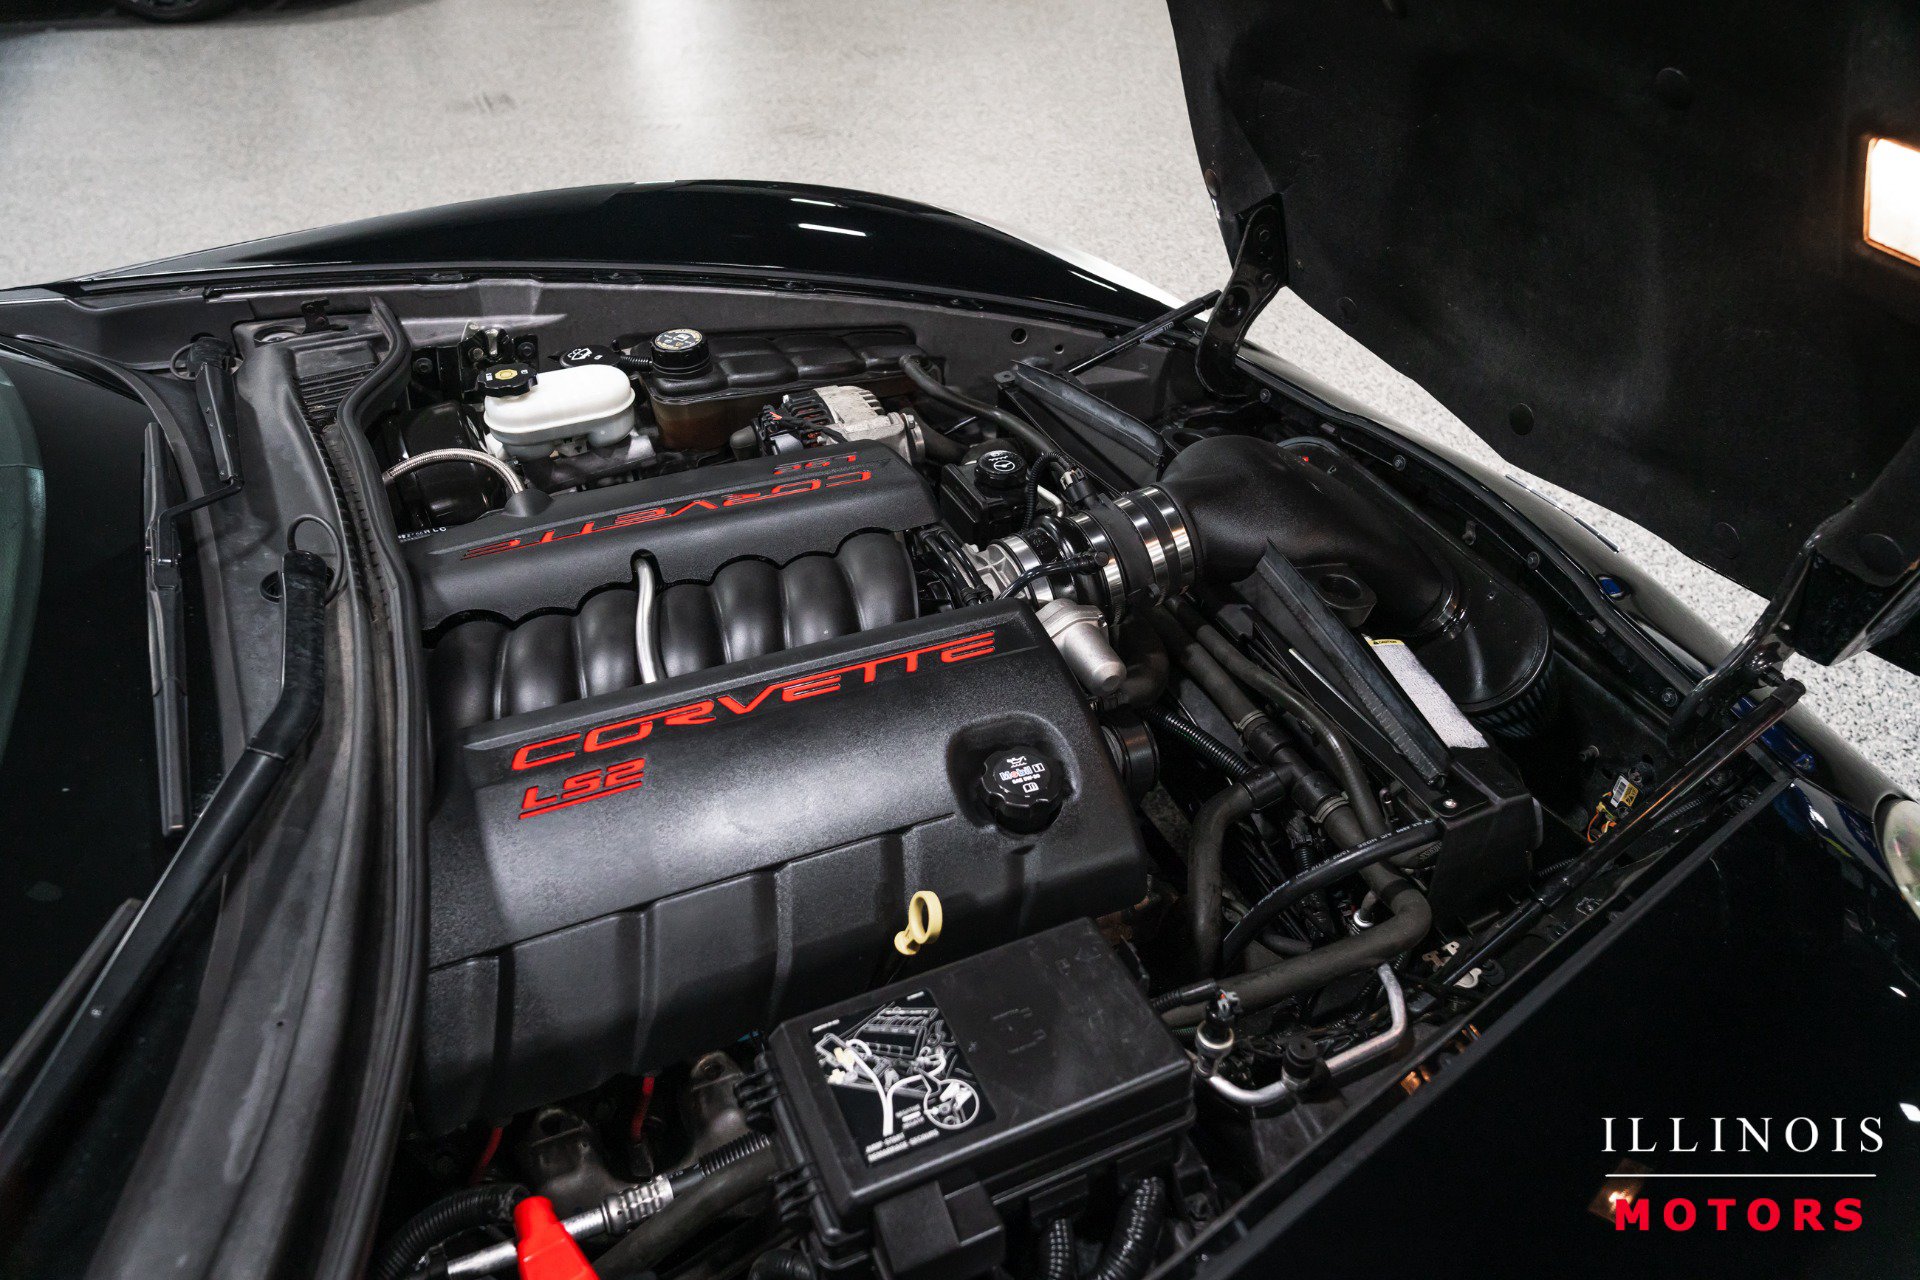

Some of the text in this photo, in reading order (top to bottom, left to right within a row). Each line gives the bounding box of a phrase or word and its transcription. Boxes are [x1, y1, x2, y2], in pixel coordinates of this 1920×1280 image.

[461, 470, 872, 560] CORVETTE
[511, 631, 995, 772] CORVETTE
[519, 757, 646, 813] LS2
[999, 766, 1033, 781] Mobil
